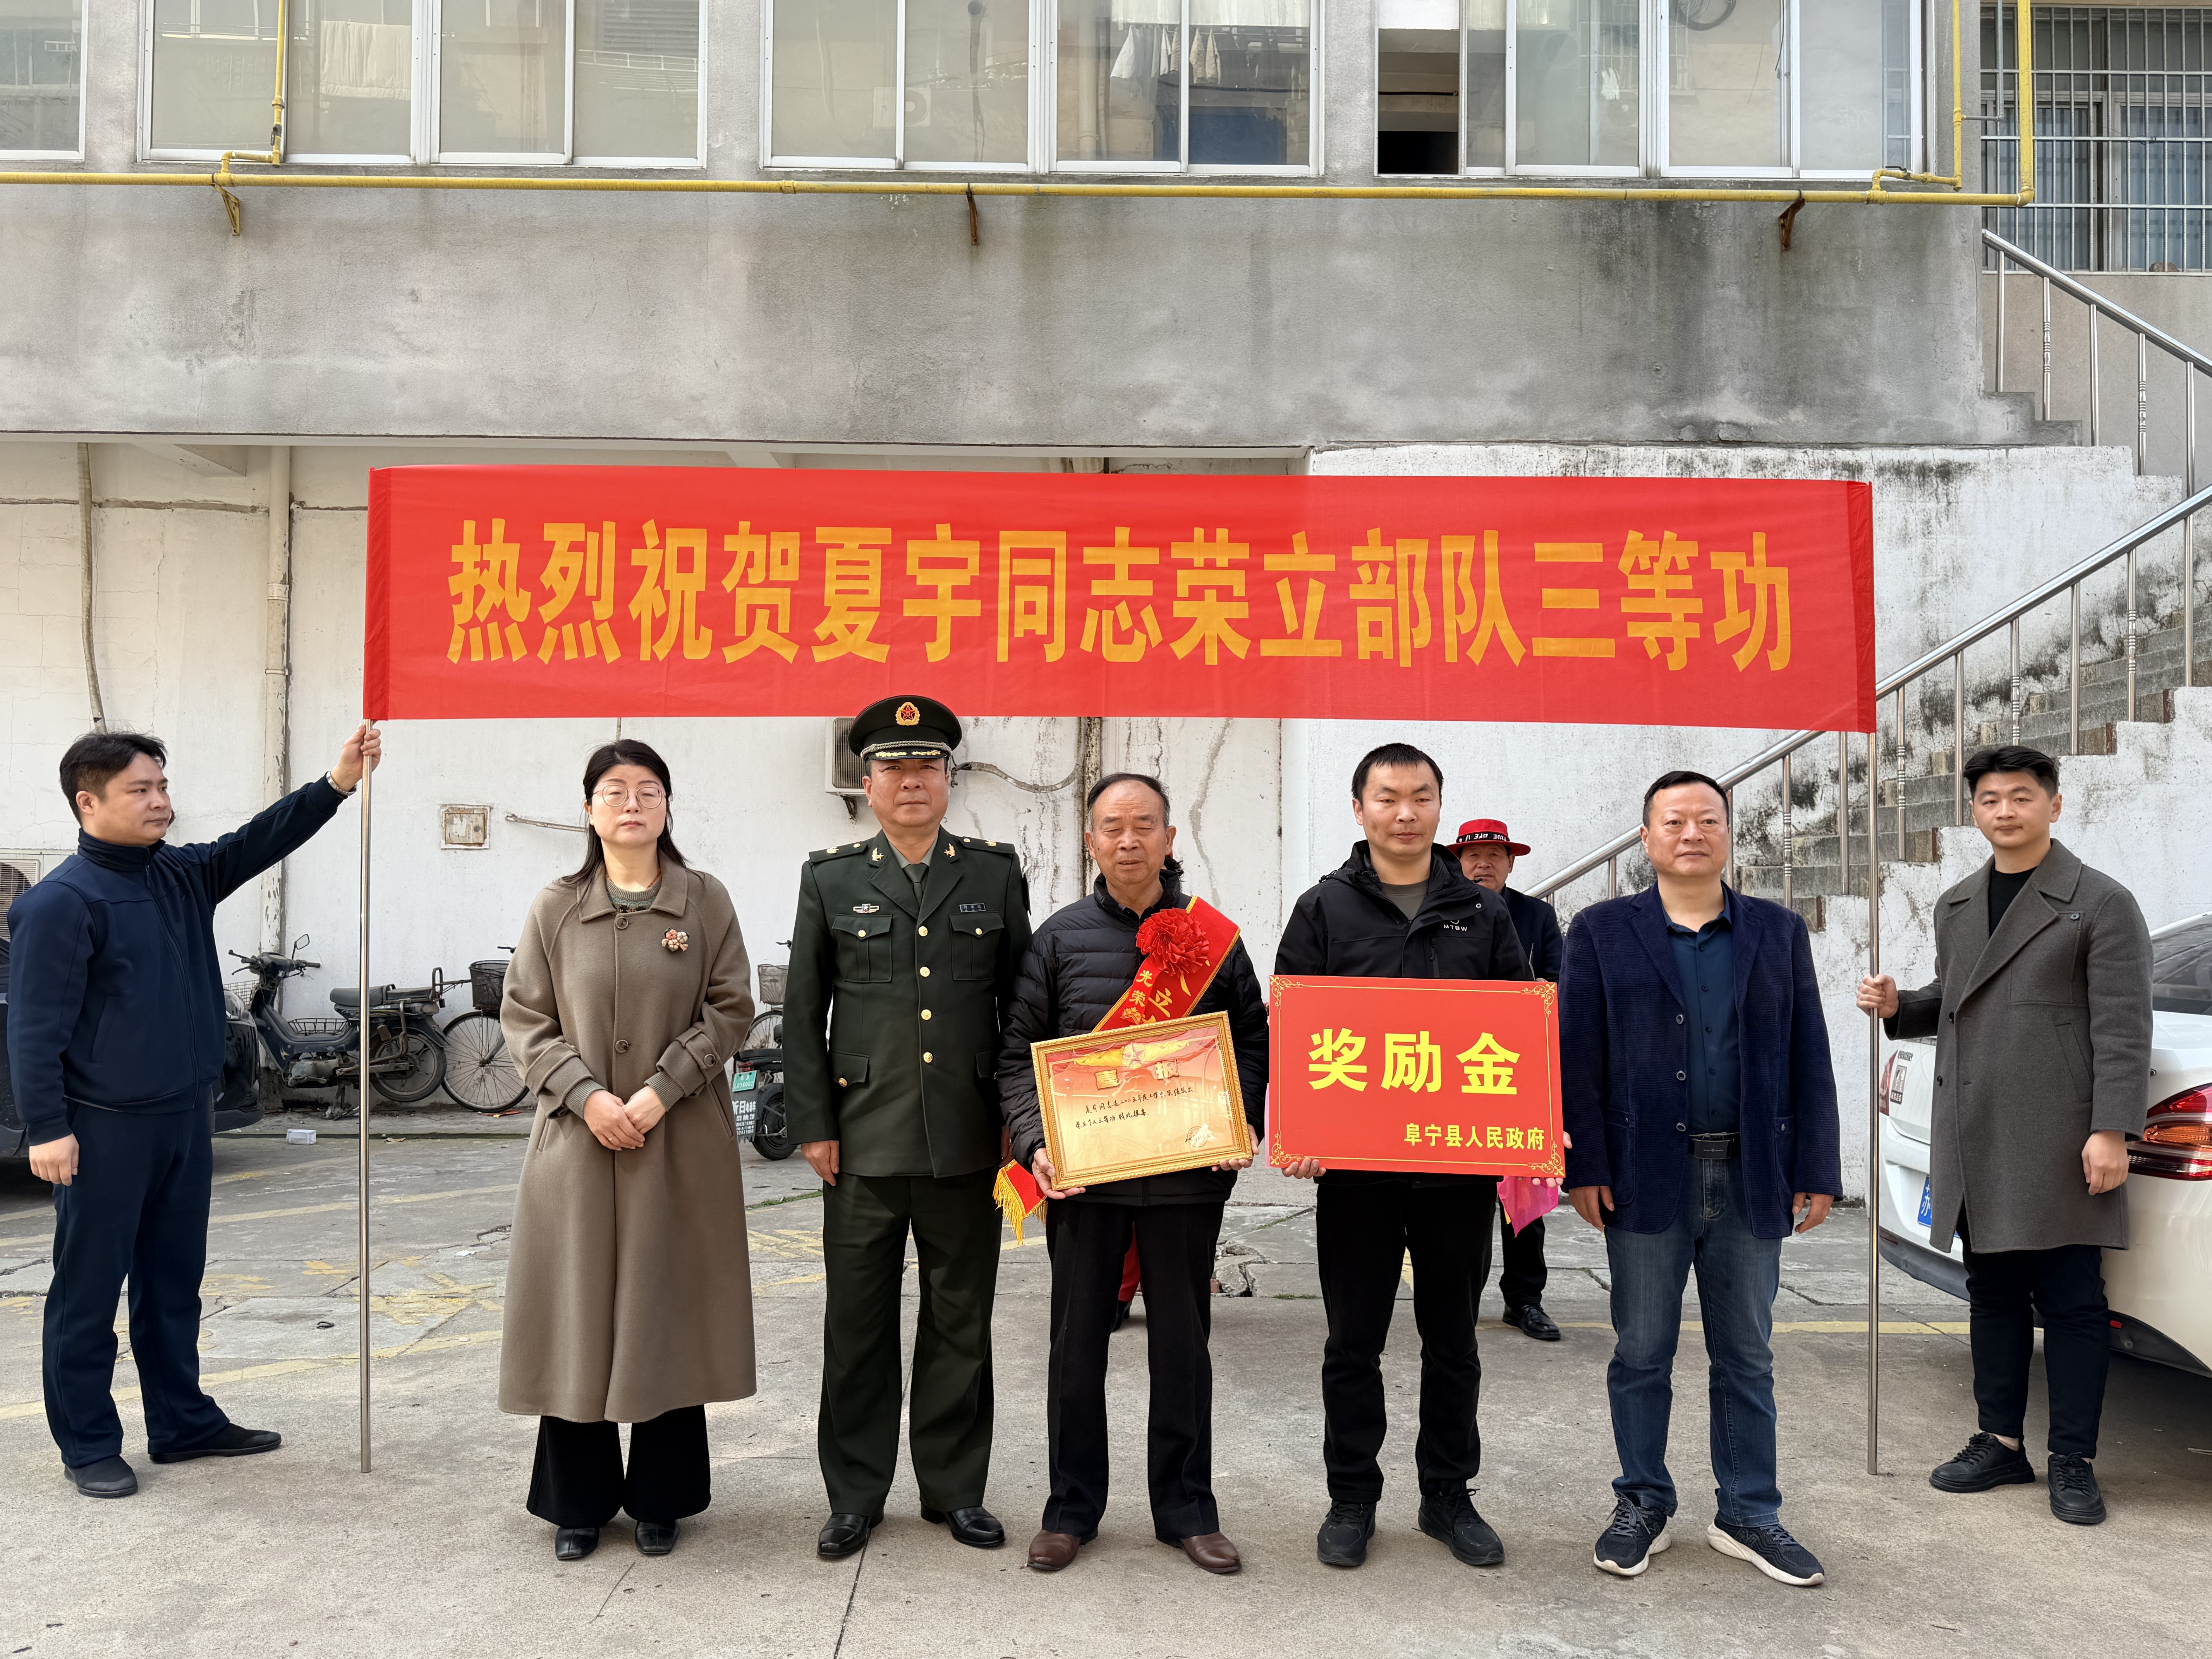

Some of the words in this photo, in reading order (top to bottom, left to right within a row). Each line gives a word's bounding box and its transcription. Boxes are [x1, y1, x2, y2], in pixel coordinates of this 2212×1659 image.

[447, 519, 1790, 672] 热烈祝贺夏宇同志荣立部队三等功
[1129, 970, 1153, 1007] 光荣
[1309, 1029, 1520, 1095] 奖励金
[1404, 1123, 1545, 1151] 阜宁县人民政府
